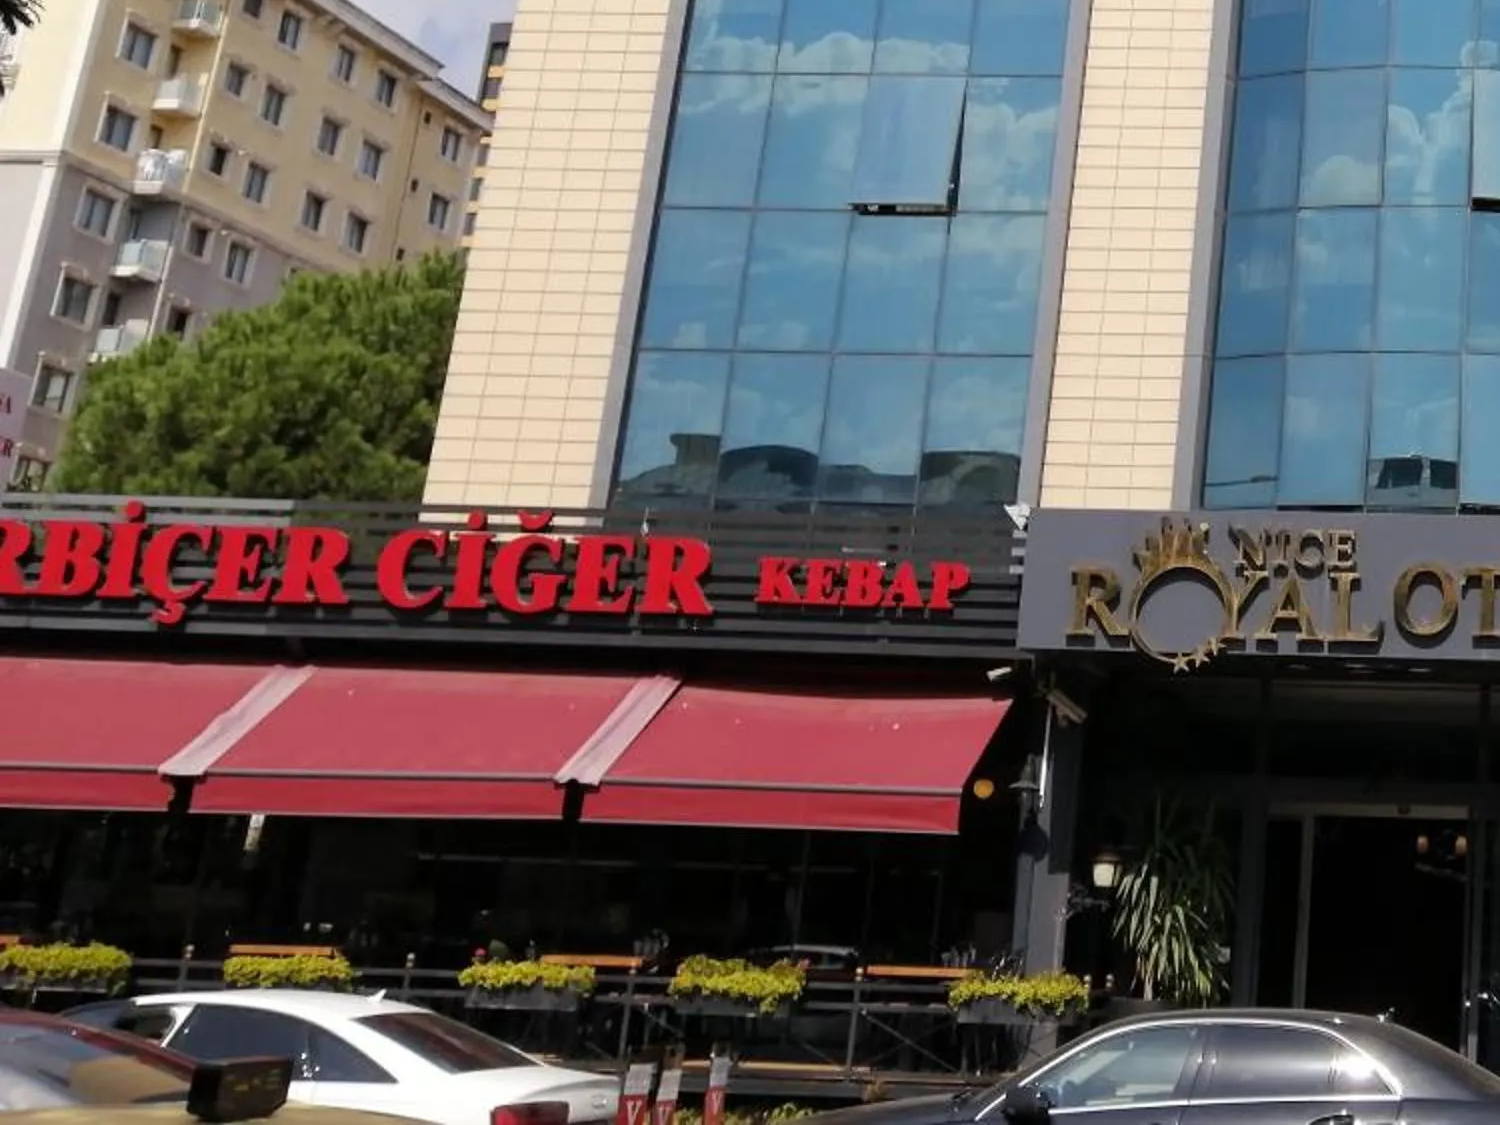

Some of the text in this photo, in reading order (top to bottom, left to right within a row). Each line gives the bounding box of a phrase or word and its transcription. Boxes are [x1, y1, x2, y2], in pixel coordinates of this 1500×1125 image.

[377, 509, 714, 615] CİĞER
[754, 555, 972, 610] KEBAP
[1229, 527, 1358, 574] NICE
[1066, 561, 1385, 665] ROYAL
